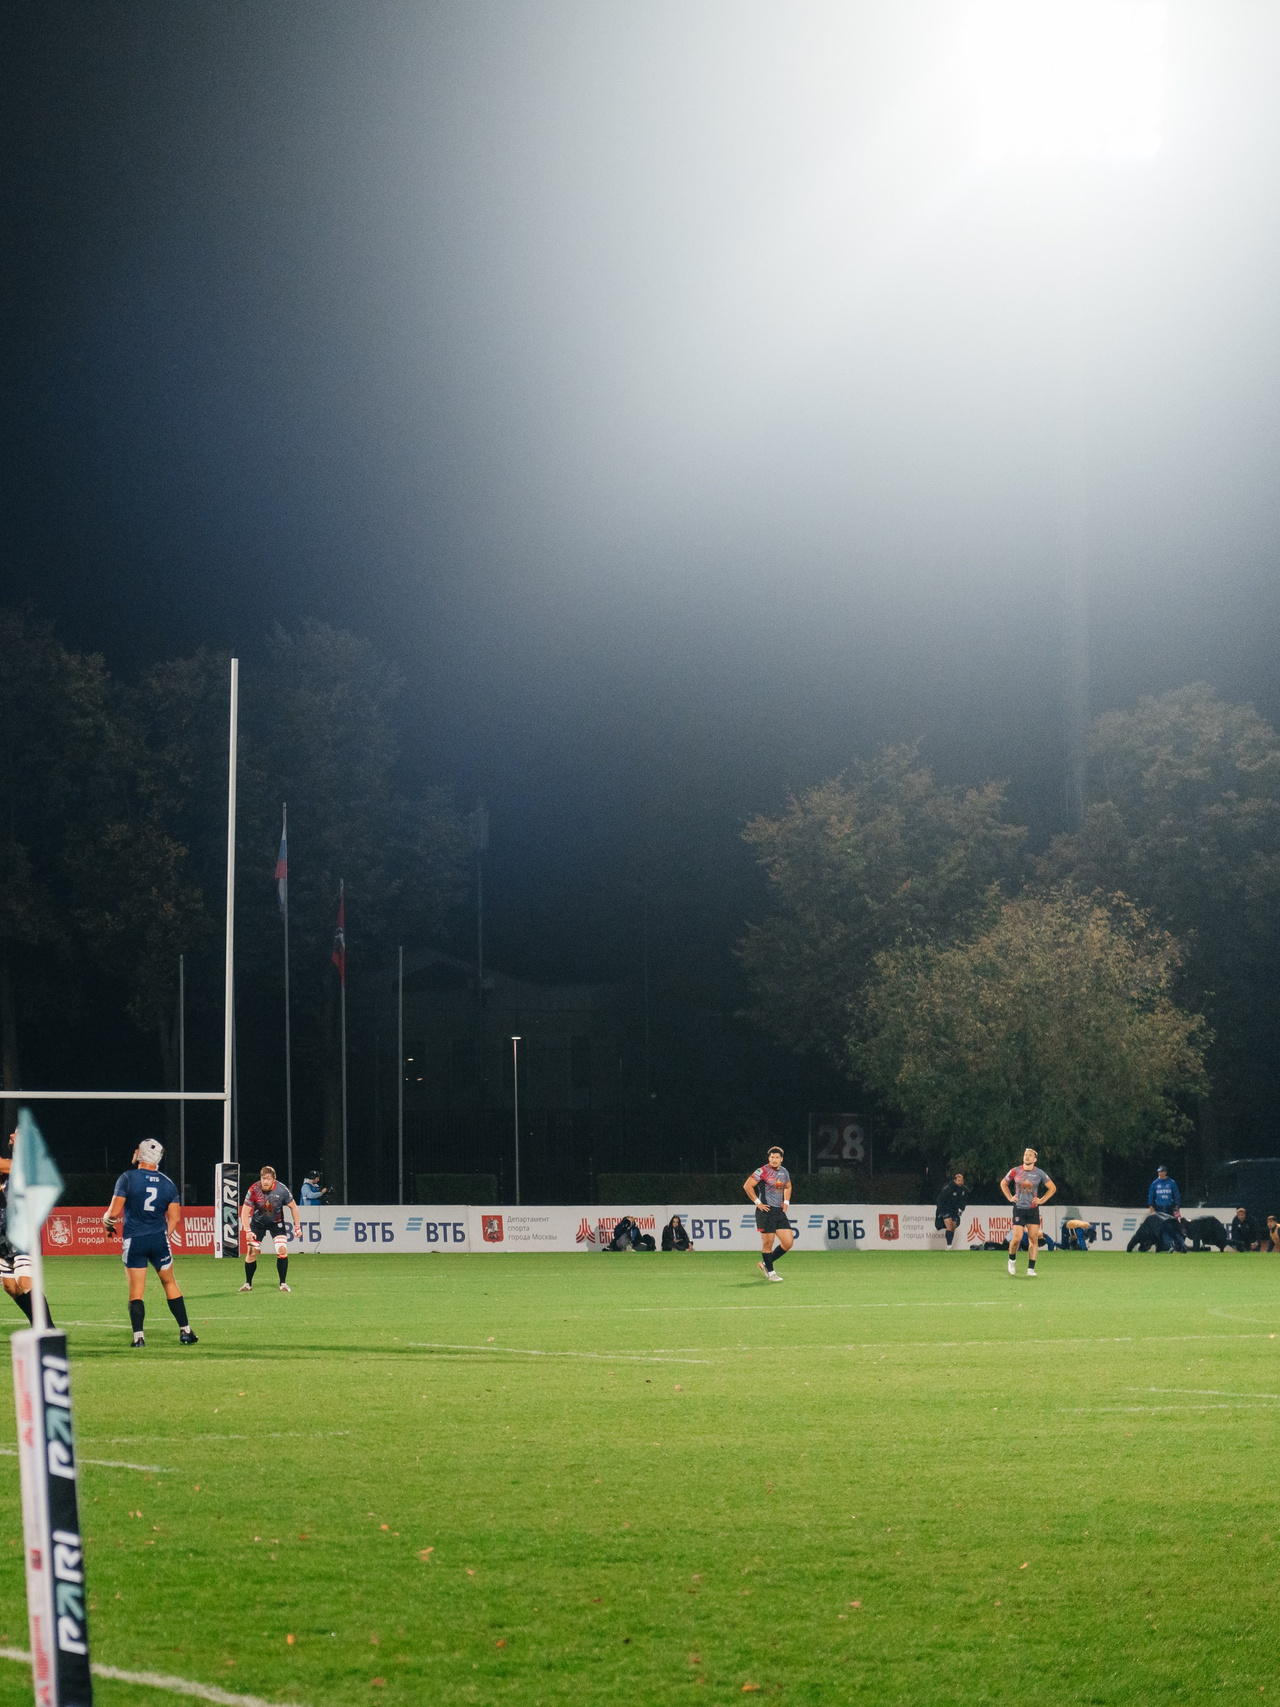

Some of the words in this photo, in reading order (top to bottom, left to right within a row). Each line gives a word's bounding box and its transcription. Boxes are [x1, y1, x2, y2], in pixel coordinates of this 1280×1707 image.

[818, 1124, 865, 1161] 28
[143, 1187, 158, 1212] 2
[77, 1227, 104, 1235] спорта
[354, 1222, 395, 1243] ВТБ
[426, 1222, 466, 1243] ВТБ
[691, 1219, 732, 1240] ВТБ
[827, 1219, 866, 1240] ВТБ
